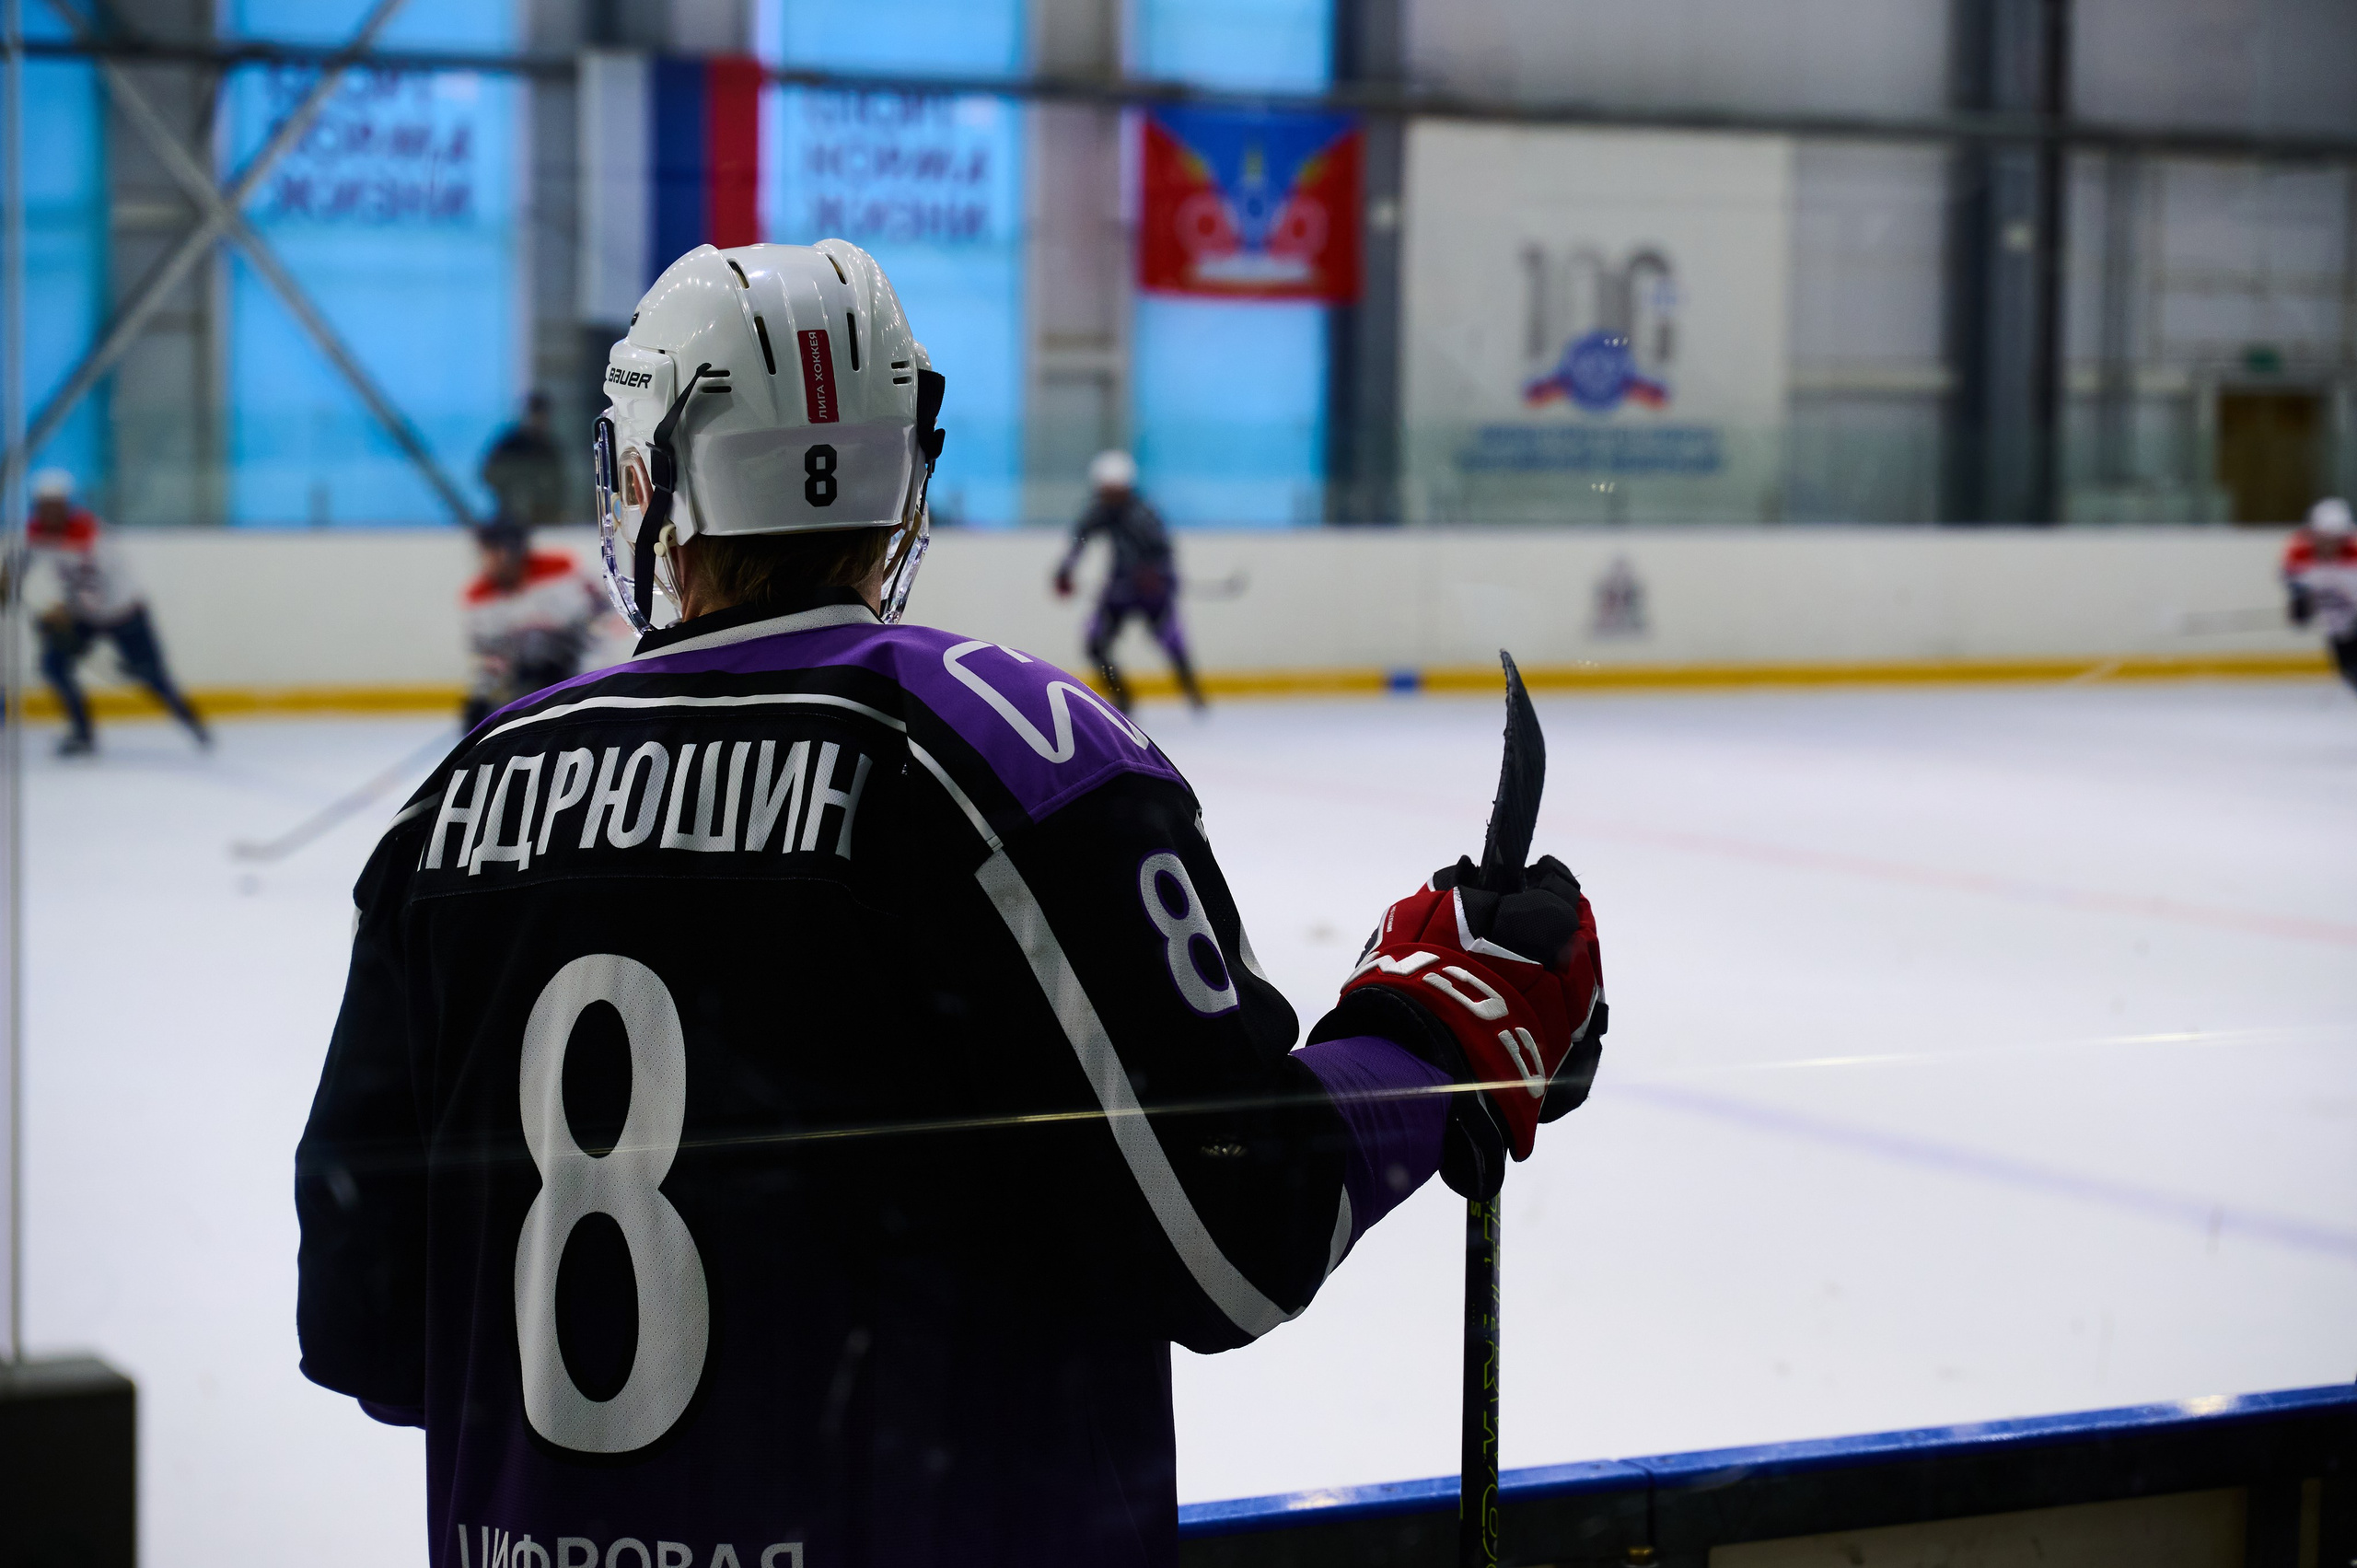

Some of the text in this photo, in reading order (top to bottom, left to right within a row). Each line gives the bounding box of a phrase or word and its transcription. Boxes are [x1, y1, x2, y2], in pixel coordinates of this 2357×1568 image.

[608, 367, 653, 389] BAUER
[808, 331, 828, 419] ЛИГА ХОККЕЯ
[804, 444, 838, 508] 8
[417, 740, 874, 877] НДРЮШИН
[1136, 848, 1240, 1018] 8
[514, 953, 710, 1453] 8
